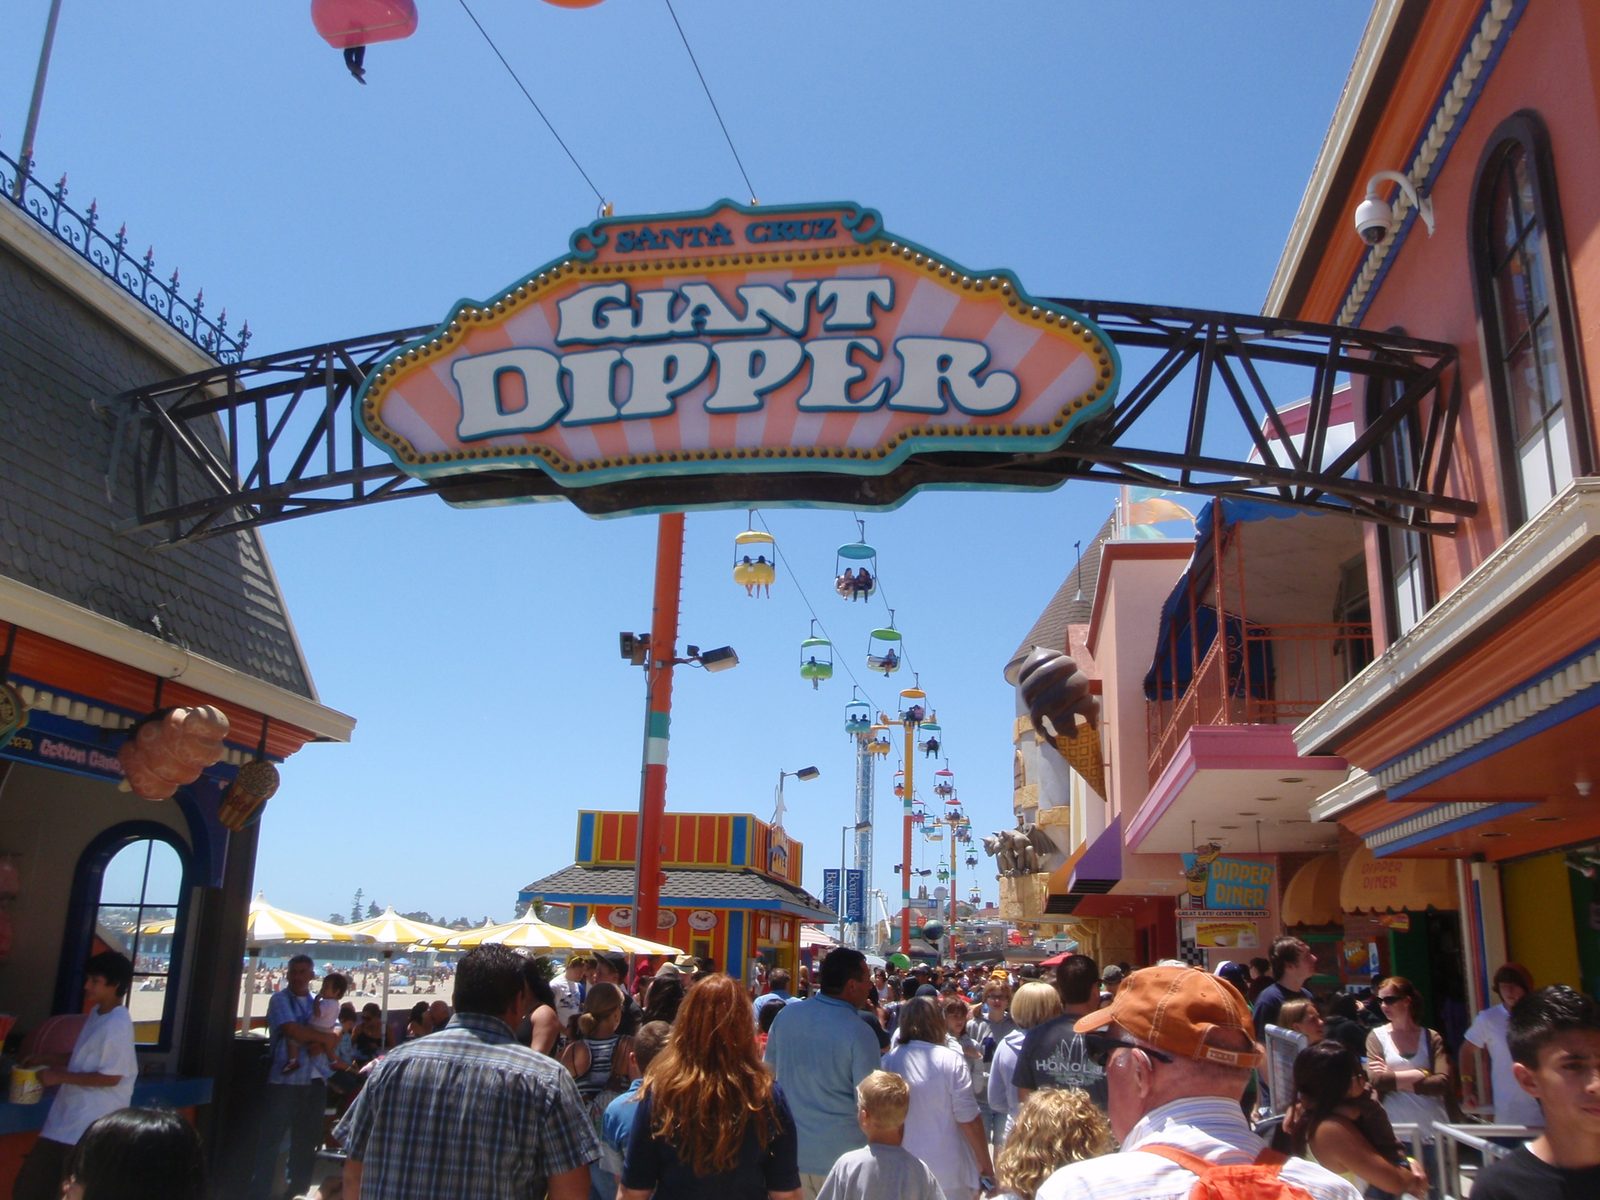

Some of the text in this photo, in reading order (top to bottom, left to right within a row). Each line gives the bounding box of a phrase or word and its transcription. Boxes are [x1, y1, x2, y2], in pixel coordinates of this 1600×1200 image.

[615, 218, 837, 253] SANTA CRUZ
[554, 276, 895, 347] GIANT
[451, 335, 1021, 442] DIPPER
[89, 750, 126, 775] Cand
[1213, 860, 1272, 886] DIPPER
[1363, 875, 1398, 889] DINER
[1216, 882, 1265, 907] DINER
